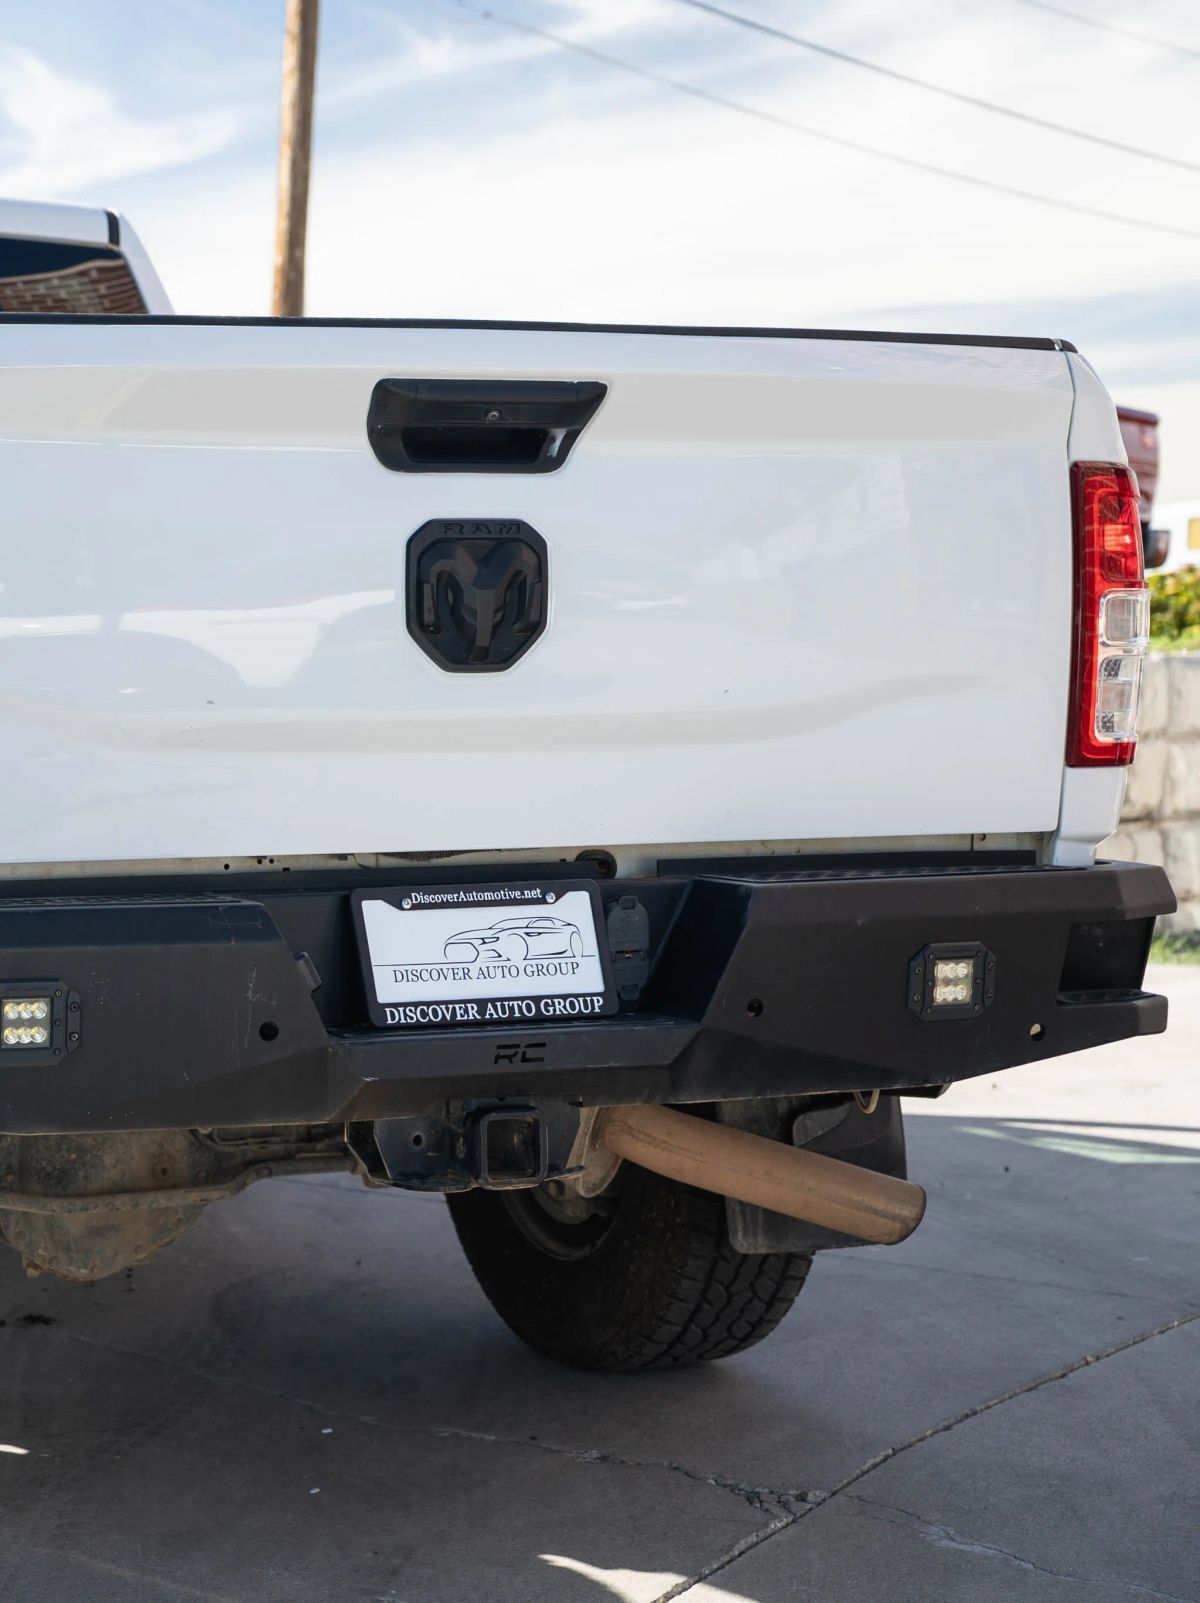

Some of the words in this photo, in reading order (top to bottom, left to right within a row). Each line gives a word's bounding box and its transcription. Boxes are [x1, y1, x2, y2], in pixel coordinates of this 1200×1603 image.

[441, 523, 521, 535] RAM
[411, 887, 542, 904] DiscoverAutomotive.net
[393, 966, 473, 983] DISCOVER
[476, 964, 520, 980] AUTO
[523, 961, 580, 978] GROUP
[384, 1003, 481, 1025] DISCOVER
[484, 1000, 536, 1019] AUTO
[540, 996, 604, 1016] GROUP
[493, 1042, 547, 1065] RC
